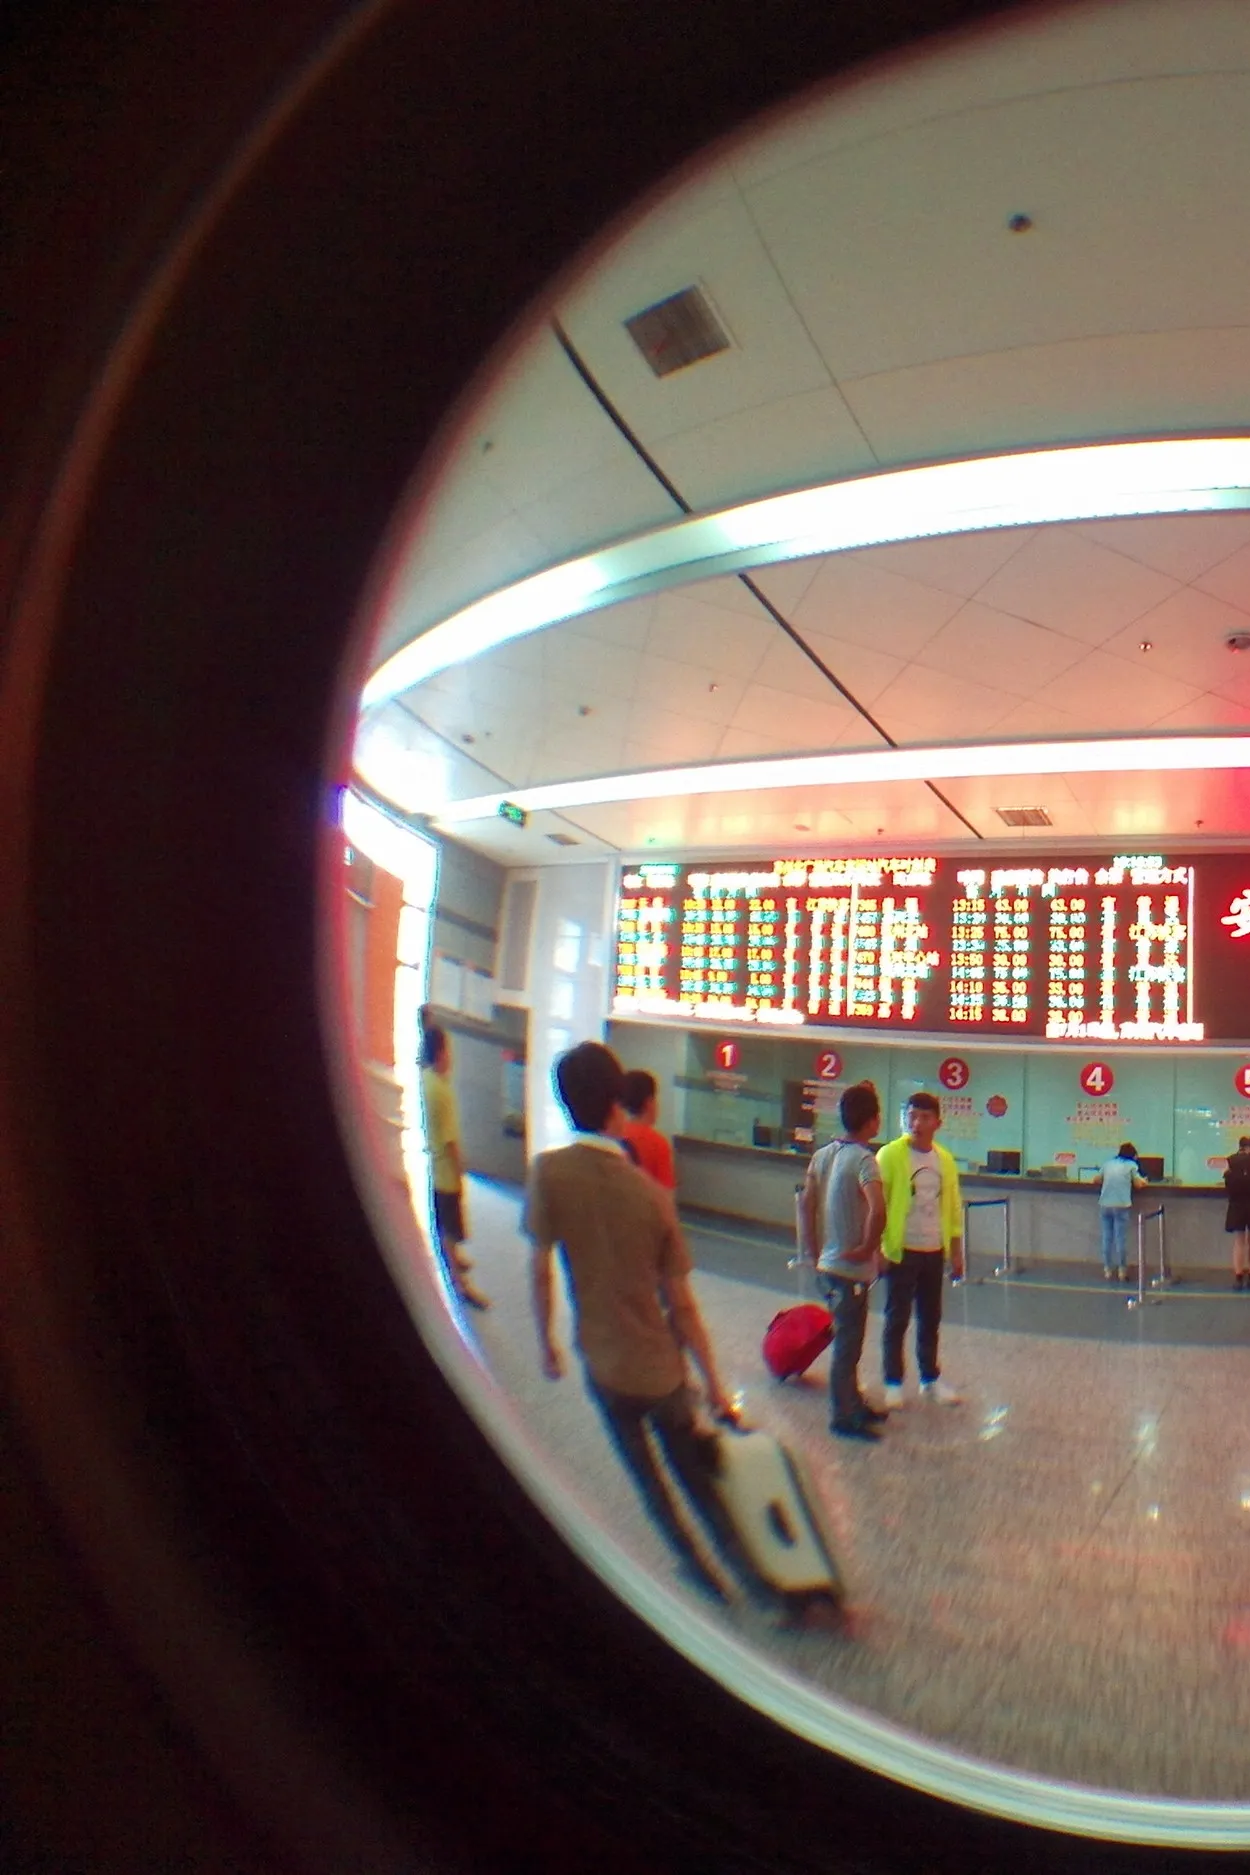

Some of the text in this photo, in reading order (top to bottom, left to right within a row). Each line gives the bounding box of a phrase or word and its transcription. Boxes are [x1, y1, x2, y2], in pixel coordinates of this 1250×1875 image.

[721, 1044, 735, 1067] 1
[820, 1054, 837, 1078] 2
[947, 1062, 963, 1086] 3
[1086, 1066, 1105, 1091] 4
